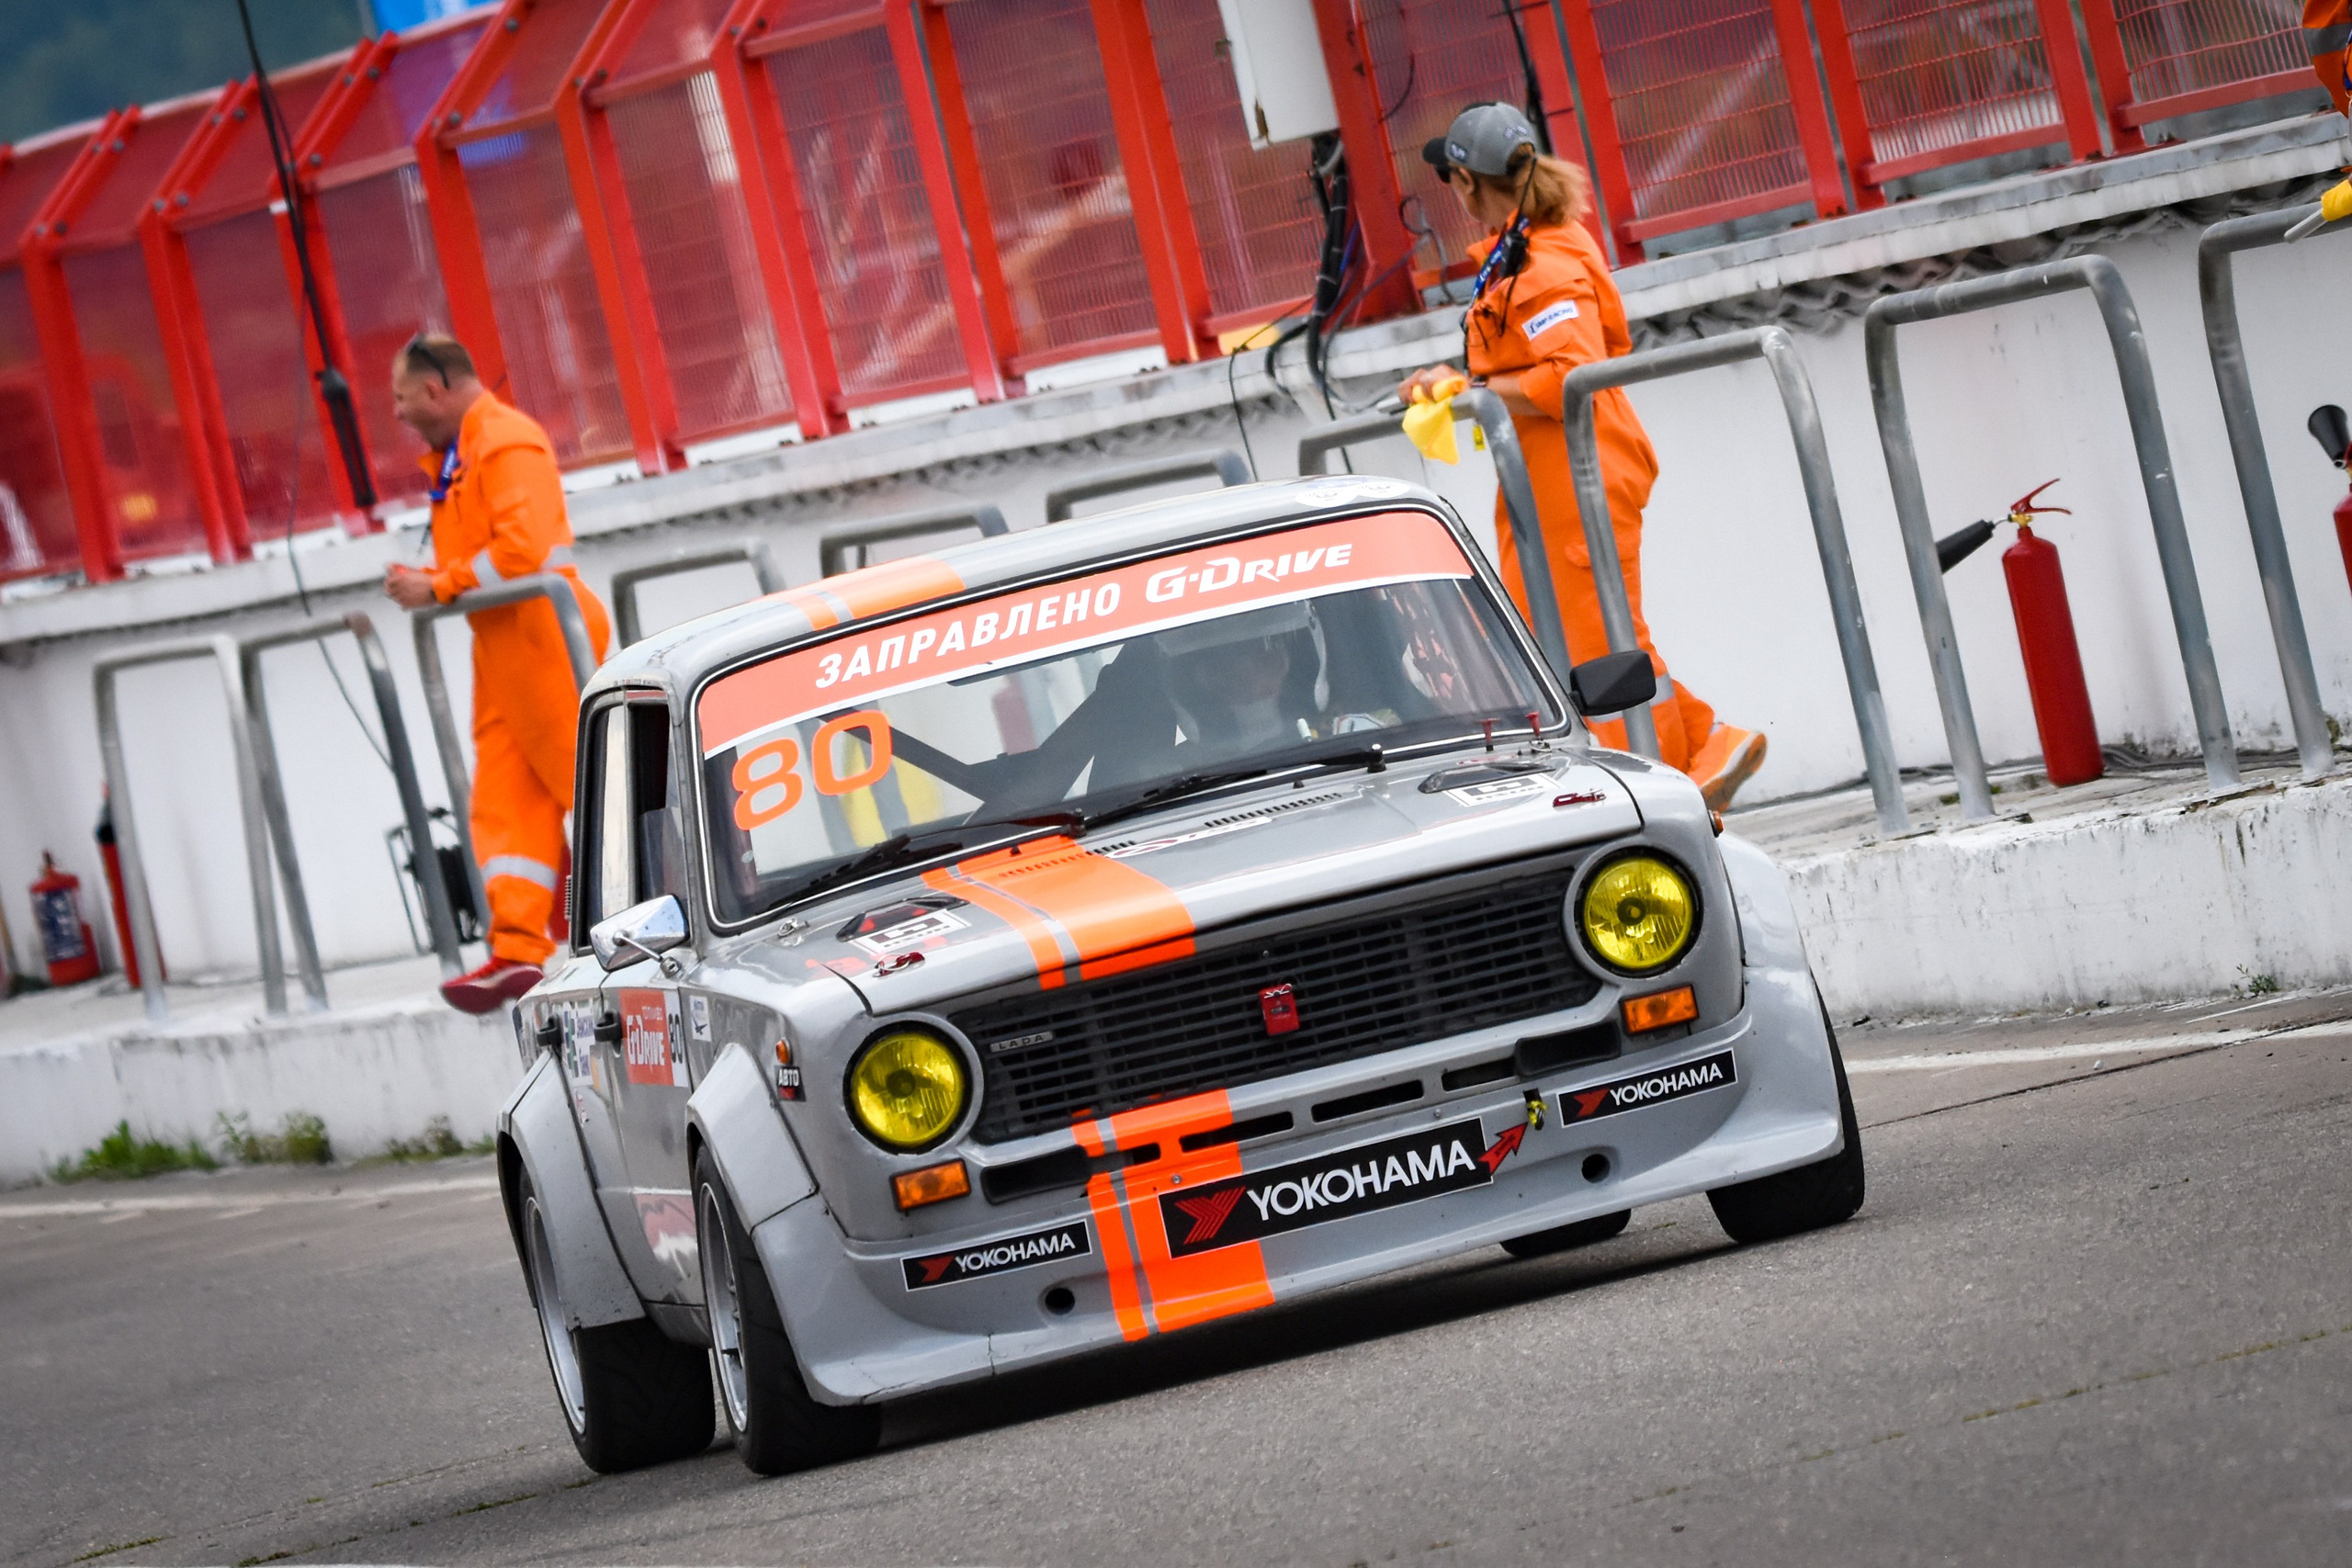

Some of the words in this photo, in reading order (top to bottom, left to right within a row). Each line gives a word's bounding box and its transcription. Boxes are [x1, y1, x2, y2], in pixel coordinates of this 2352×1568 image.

[815, 582, 1121, 689] ЗАПРАВЛЕНО
[731, 709, 893, 831] 80
[669, 1013, 684, 1064] 80
[998, 1034, 1044, 1050] LADA
[778, 1068, 800, 1088] АВТО
[1610, 1063, 1724, 1106] YOKOHAMA
[1247, 1140, 1476, 1222] YOKOHAMA
[955, 1233, 1076, 1273] YOKOHAMA
